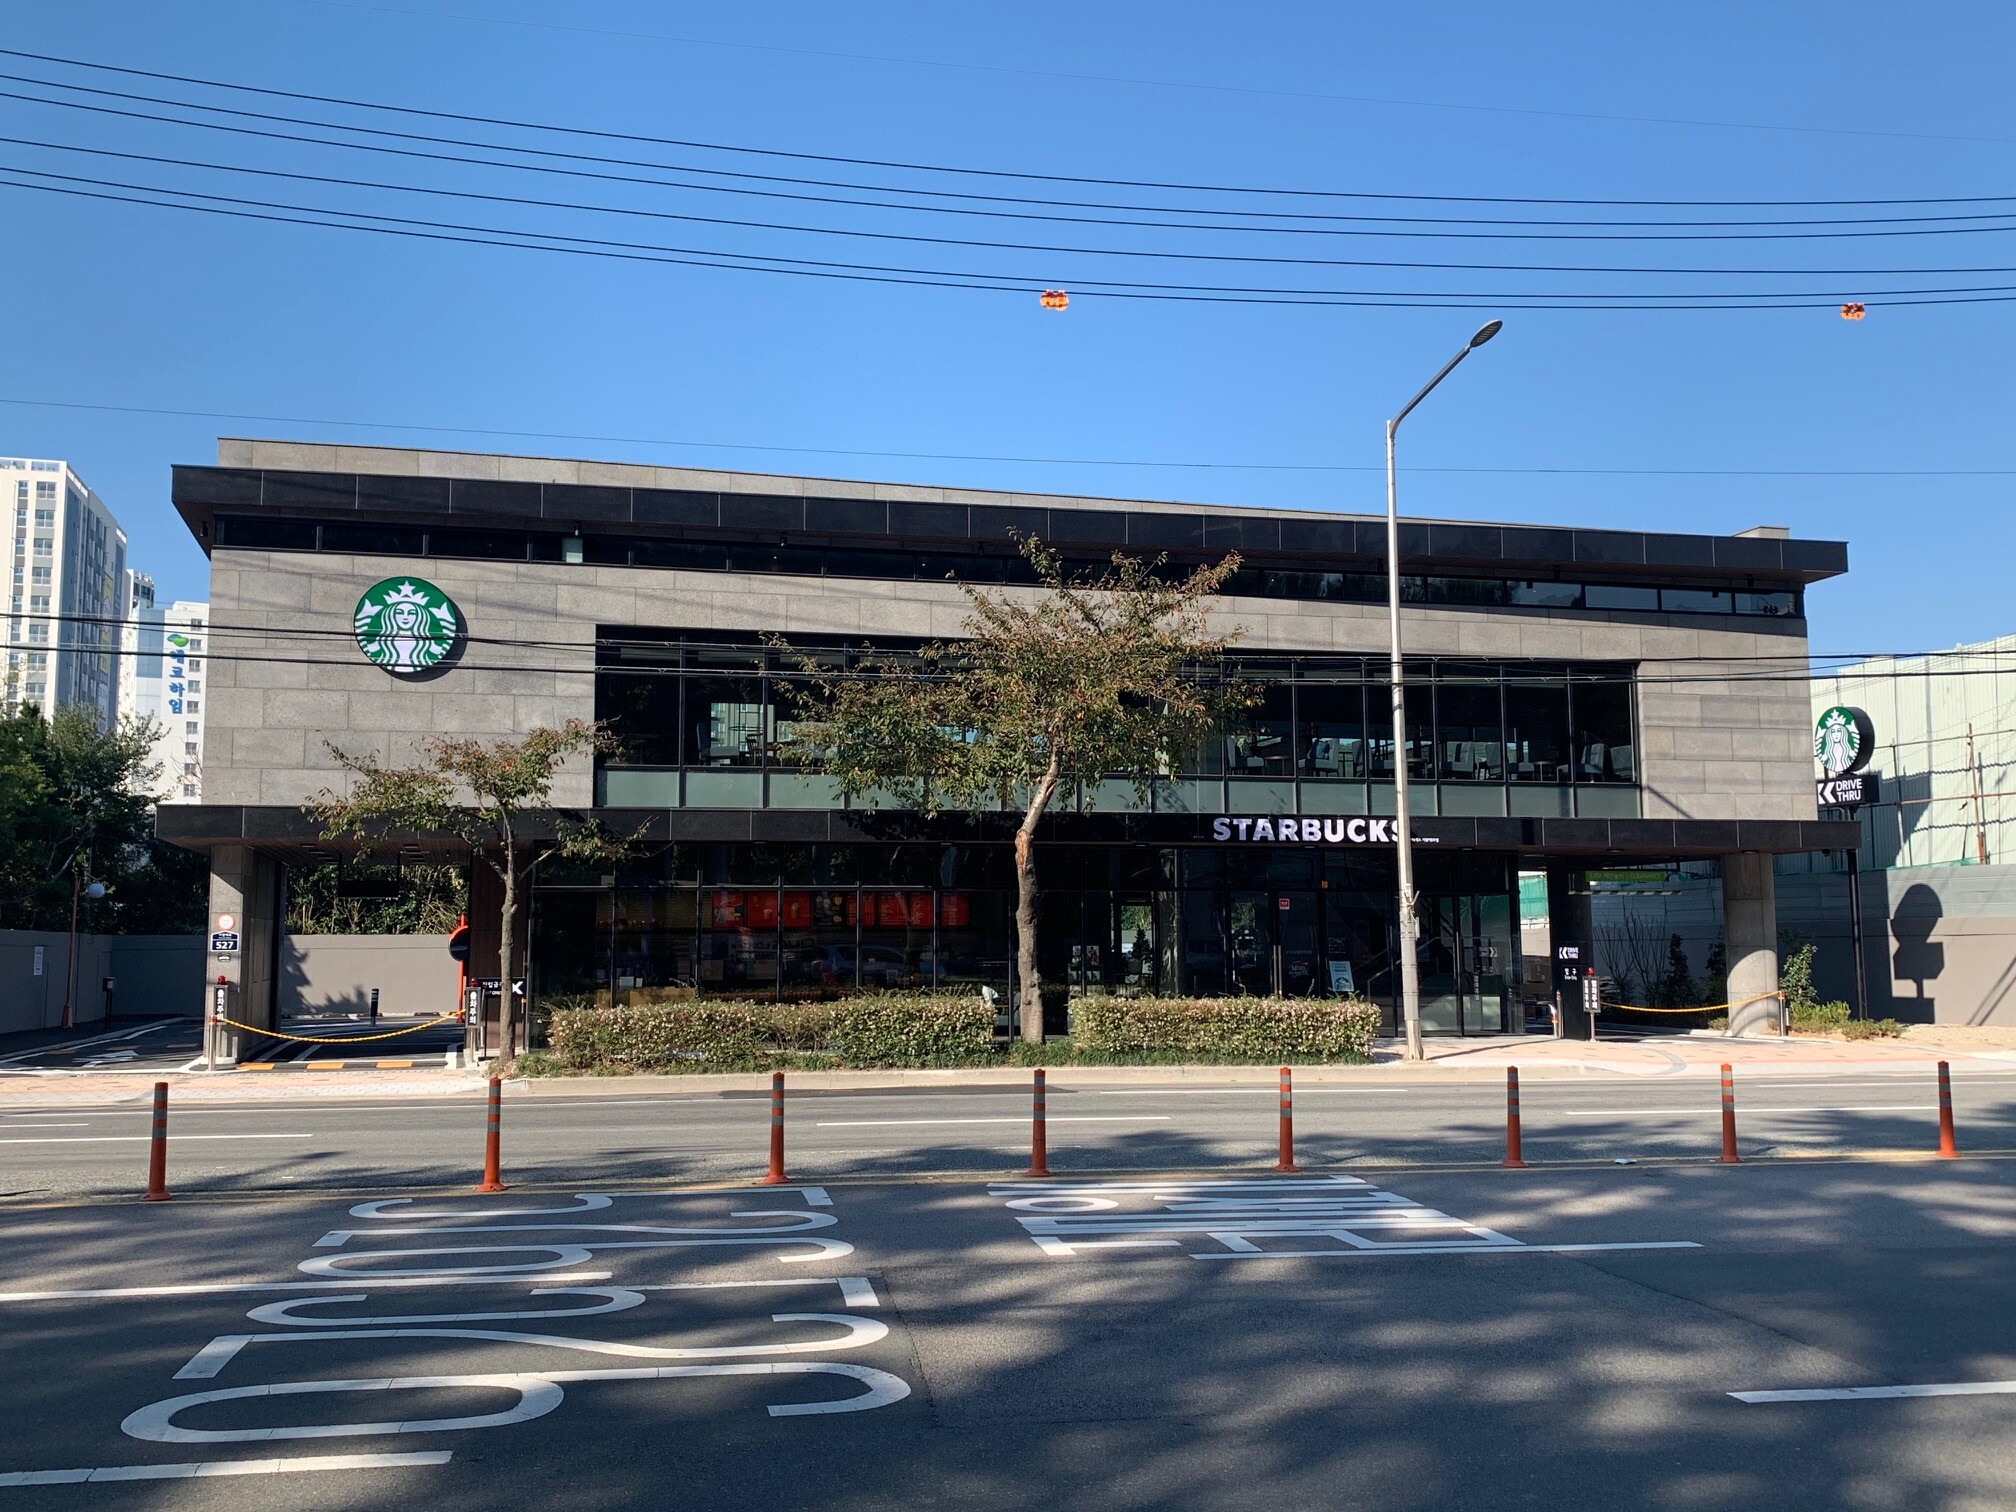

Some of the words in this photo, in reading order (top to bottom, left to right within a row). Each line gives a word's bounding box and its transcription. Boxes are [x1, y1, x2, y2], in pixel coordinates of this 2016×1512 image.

[168, 649, 185, 714] 에코하임
[1836, 778, 1863, 791] DRIVE
[1836, 790, 1862, 802] THRU
[216, 941, 234, 949] 527
